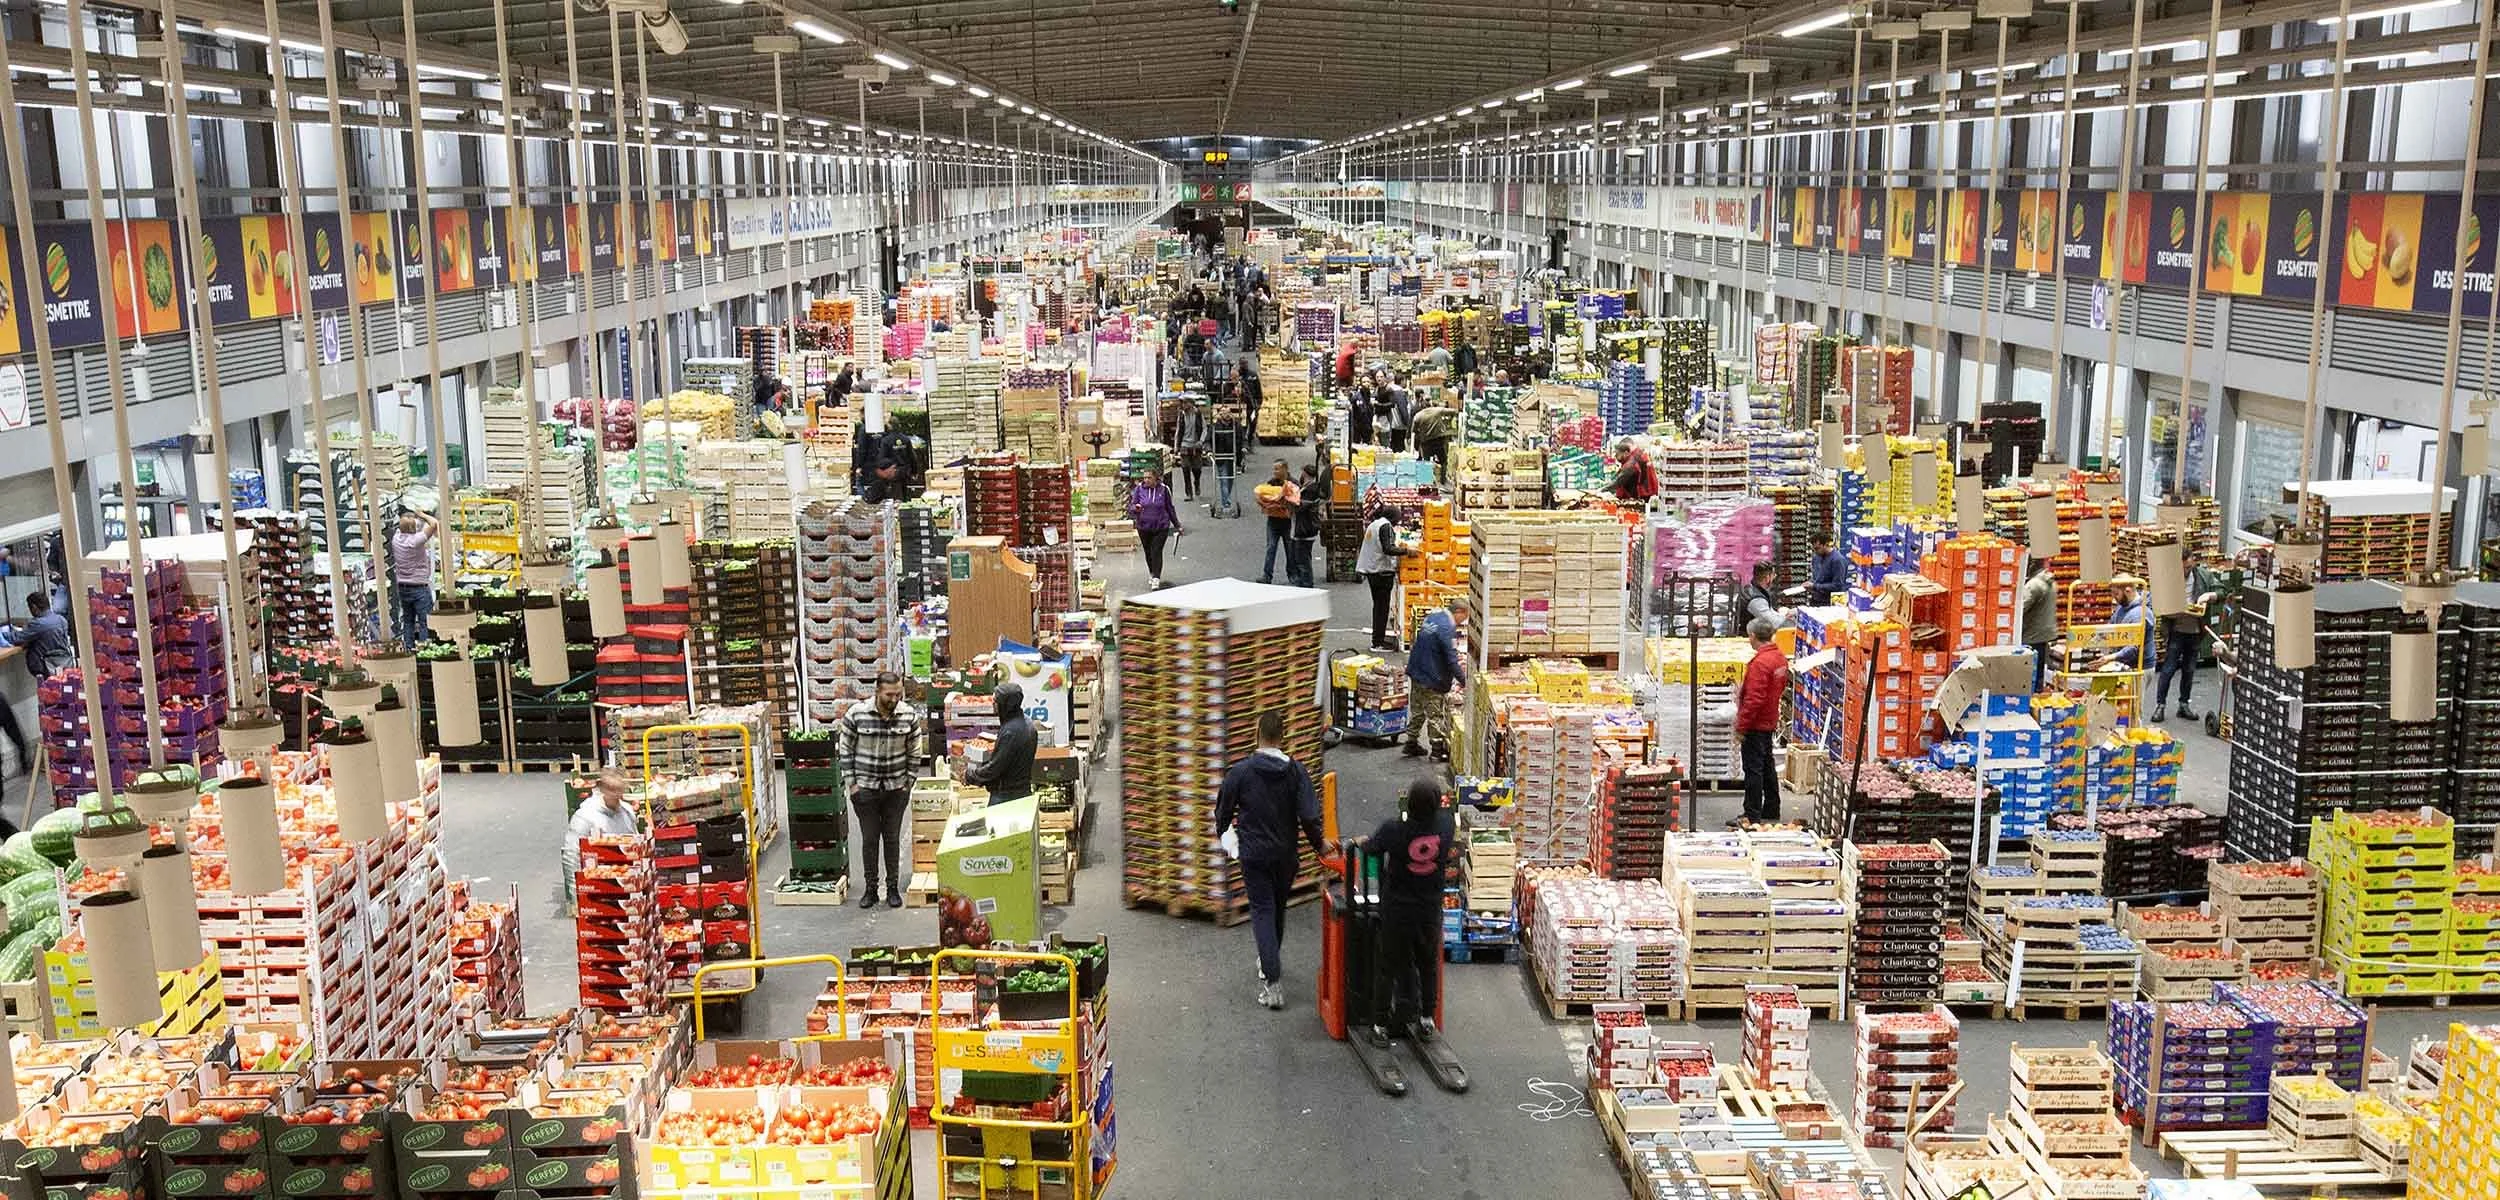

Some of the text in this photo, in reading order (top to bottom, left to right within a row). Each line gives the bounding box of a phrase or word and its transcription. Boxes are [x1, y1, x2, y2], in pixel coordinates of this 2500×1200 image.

[770, 202, 783, 236] Jea
[2277, 259, 2319, 279] DESMETTR
[309, 273, 343, 290] DESMETTRE
[2432, 270, 2495, 293] DESETTRE
[45, 299, 91, 322] ESMETTRE
[964, 857, 1009, 870] Savéol
[1889, 861, 1929, 870] Charlotte
[1889, 876, 1929, 885] Charlotte
[1887, 892, 1927, 901] Charlotte
[1887, 908, 1927, 917] Charlotte
[1885, 925, 1925, 934] Charlotte
[1883, 942, 1923, 951] Charlotte
[1882, 957, 1922, 966] Charlotte
[1883, 974, 1923, 983] Charlotte
[1881, 989, 1921, 998] Charlotte
[162, 1130, 197, 1149] PERFEKT
[277, 1129, 314, 1149] PERFEKT
[406, 1127, 442, 1146] PERFEKT
[525, 1123, 560, 1142] PERFEKT
[167, 1173, 202, 1190] PERFEKT
[286, 1171, 322, 1191] PERFEKT
[411, 1168, 446, 1187] PERFEKT
[529, 1165, 564, 1184] PERFEKT
